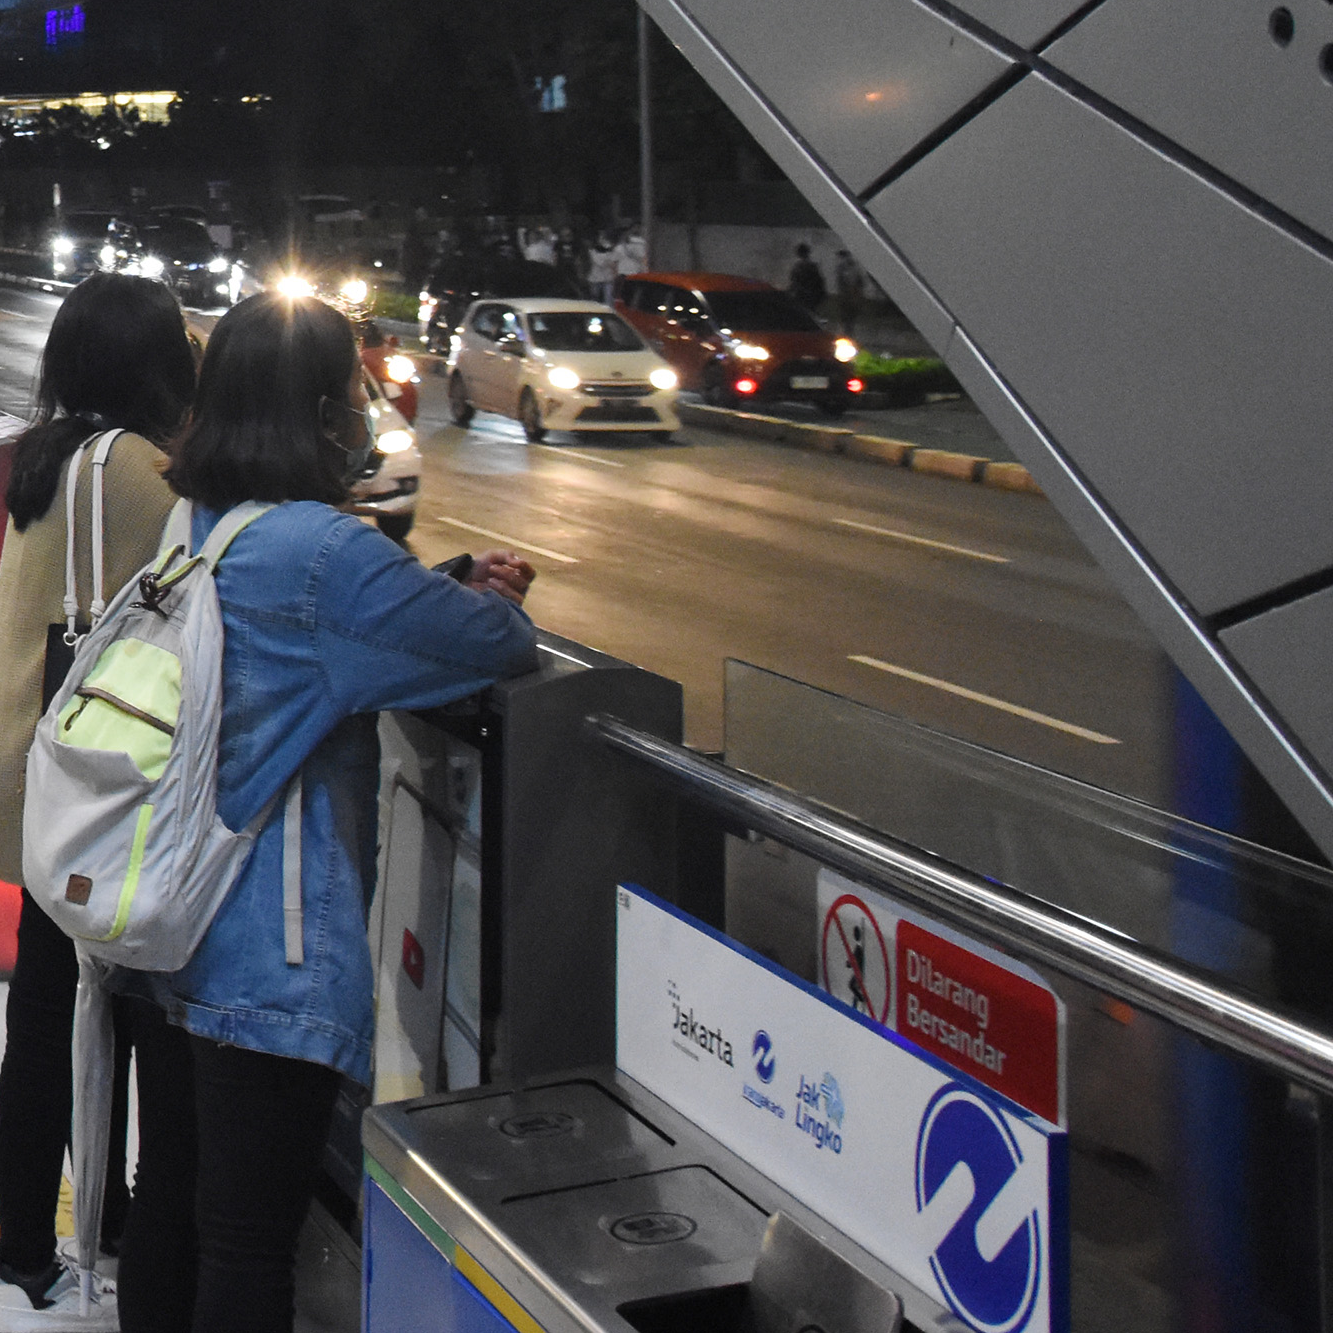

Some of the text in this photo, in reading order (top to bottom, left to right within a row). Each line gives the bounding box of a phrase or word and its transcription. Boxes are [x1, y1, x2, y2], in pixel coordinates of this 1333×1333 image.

[906, 950, 989, 1029] Dilarang
[672, 1003, 734, 1068] Jakarta
[906, 997, 1007, 1076] Bersandar
[796, 1074, 821, 1111] Jak
[795, 1102, 843, 1155] Lingko
